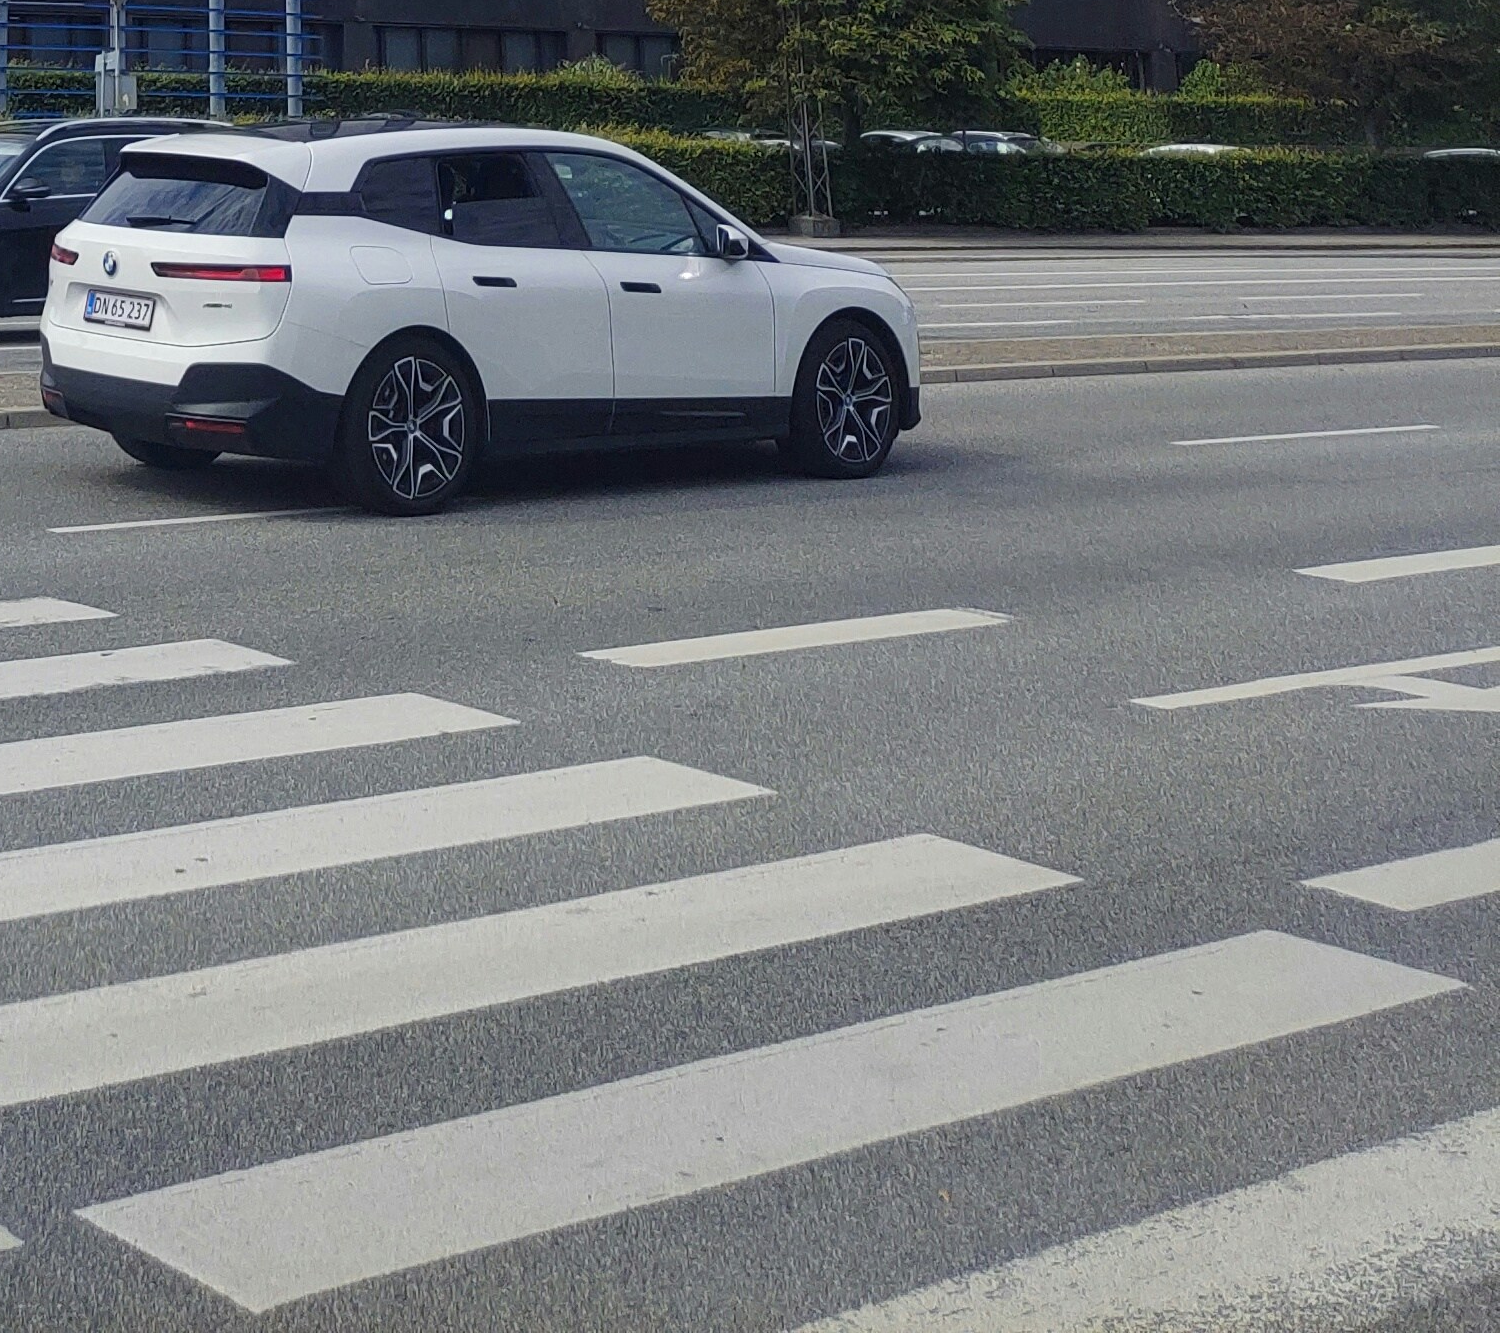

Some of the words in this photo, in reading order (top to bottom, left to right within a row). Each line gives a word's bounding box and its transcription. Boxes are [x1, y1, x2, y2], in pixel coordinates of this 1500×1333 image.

[94, 296, 110, 316] DN
[111, 299, 126, 318] 65
[127, 301, 150, 322] 237
